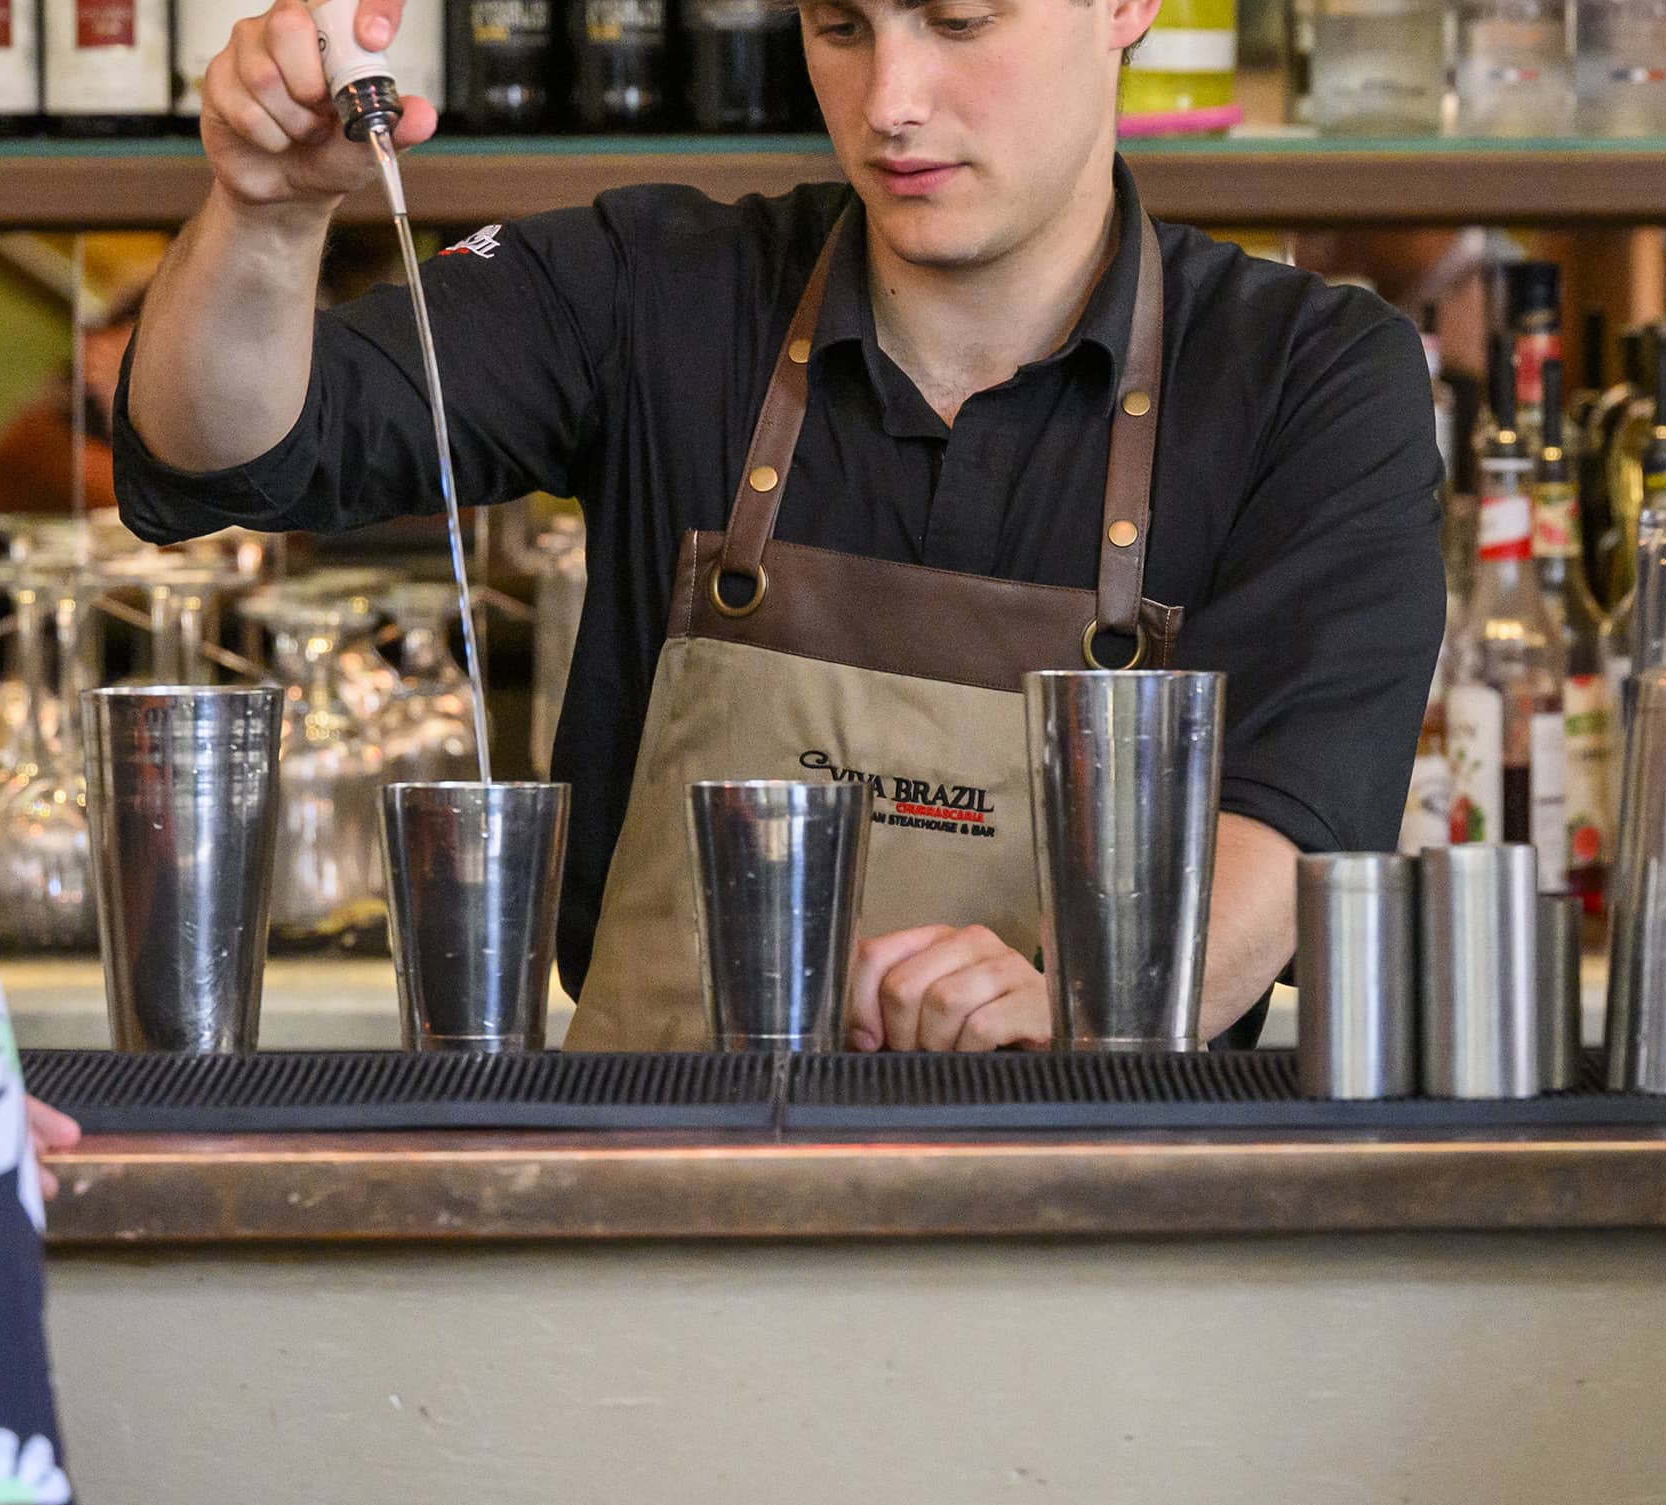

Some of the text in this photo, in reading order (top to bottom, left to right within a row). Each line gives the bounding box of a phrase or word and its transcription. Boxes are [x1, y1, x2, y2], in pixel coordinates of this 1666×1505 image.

[891, 776, 995, 813] BRAZIL
[888, 813, 958, 834] STEAKHOUSE
[971, 824, 995, 838] BAR
